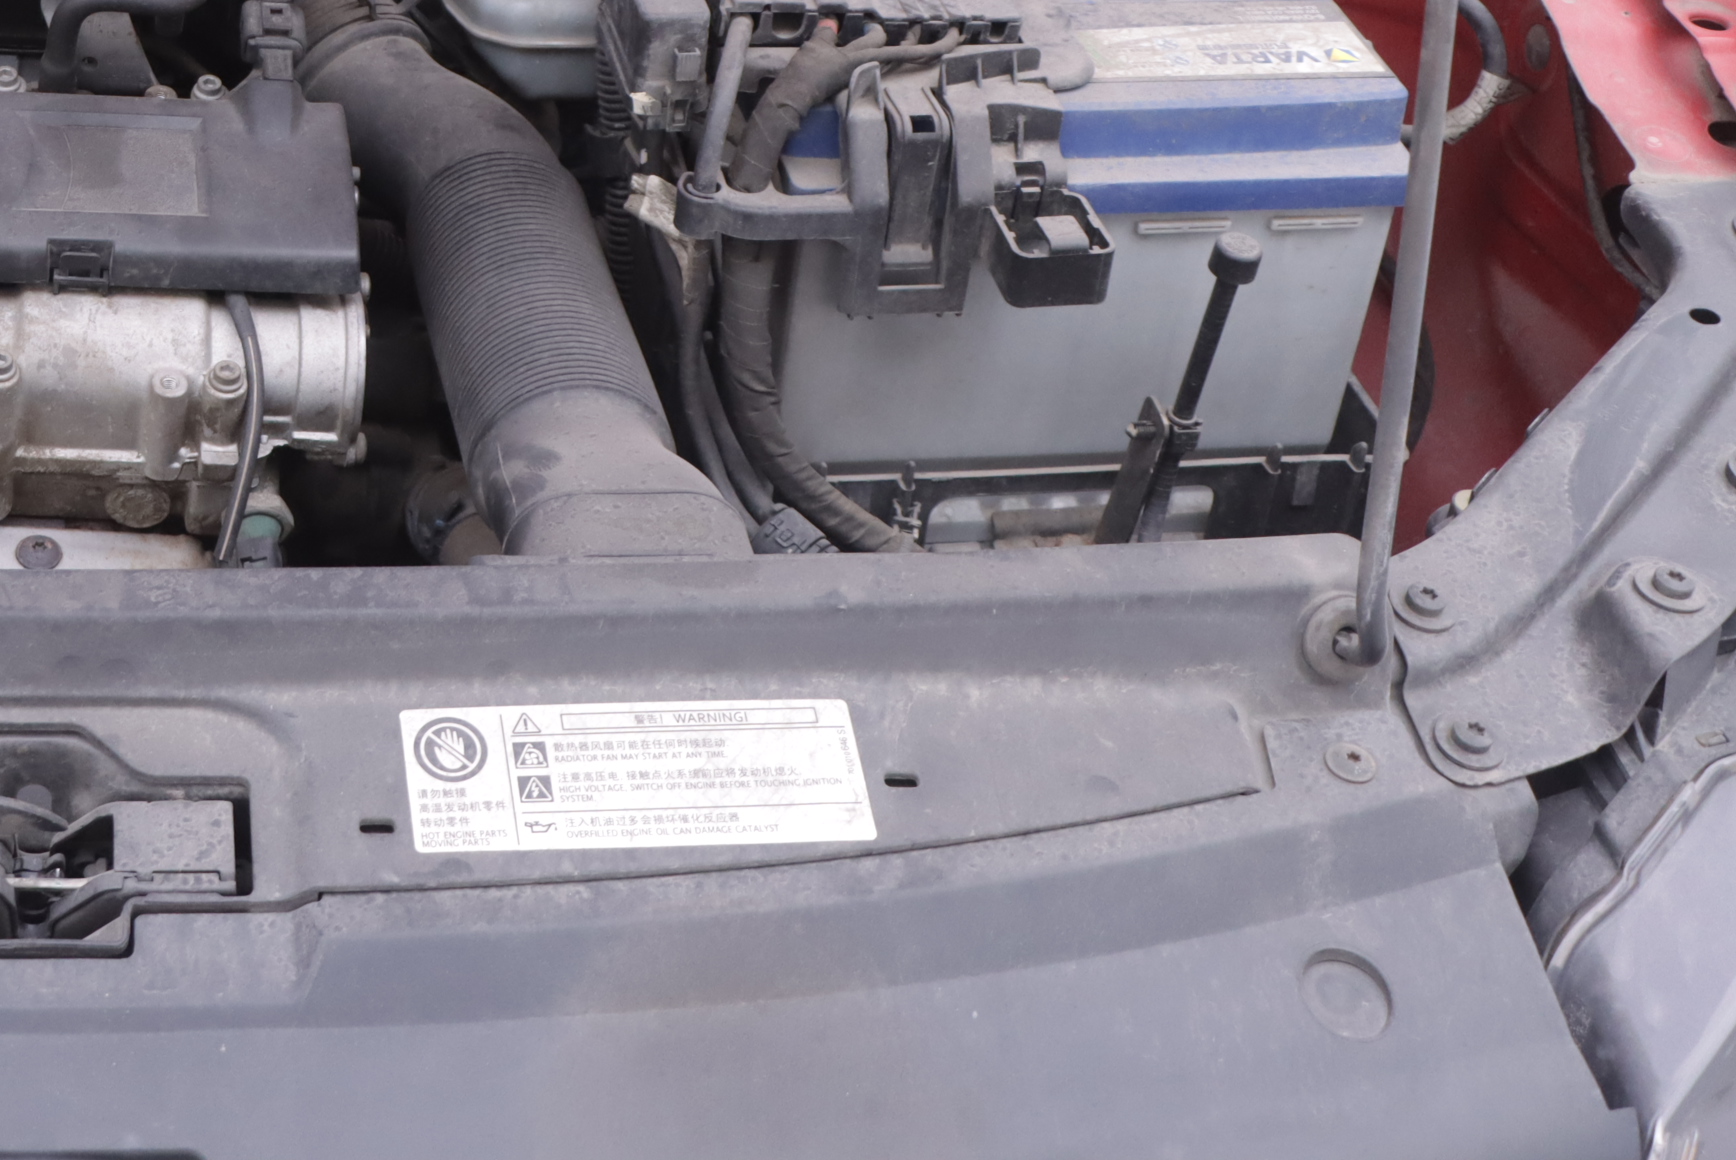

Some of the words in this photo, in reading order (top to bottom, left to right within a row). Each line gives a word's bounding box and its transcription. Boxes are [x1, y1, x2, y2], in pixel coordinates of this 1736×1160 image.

[1204, 50, 1323, 65] VARTA
[554, 754, 598, 763] RADIATOR
[601, 753, 618, 762] FAN
[621, 752, 639, 760] MAY
[642, 752, 668, 760] START
[672, 751, 682, 760] AT
[686, 751, 702, 759] ANY
[558, 785, 581, 794] HIGH
[630, 782, 663, 792] SWITCH
[666, 782, 682, 790] OFF
[685, 781, 718, 790] ENGINE
[720, 780, 752, 788] BEFORE
[755, 778, 800, 788] TOUCHING
[802, 778, 842, 788] IGNITION
[417, 788, 468, 799] 请勿触摸
[419, 800, 506, 814] 高温发动机零件
[420, 816, 470, 828] 转动零件
[421, 832, 440, 840] HOT
[444, 830, 476, 840] ENGINE
[479, 830, 508, 838] PARTS
[566, 829, 618, 839] OVERFILLED
[621, 828, 653, 838] ENGINE
[656, 828, 670, 836] OIL
[672, 826, 692, 836] CAN
[695, 826, 732, 835] DAMAGE
[736, 824, 780, 834] CATALYST
[422, 838, 460, 848] MOVING
[462, 838, 490, 846] PARTS
